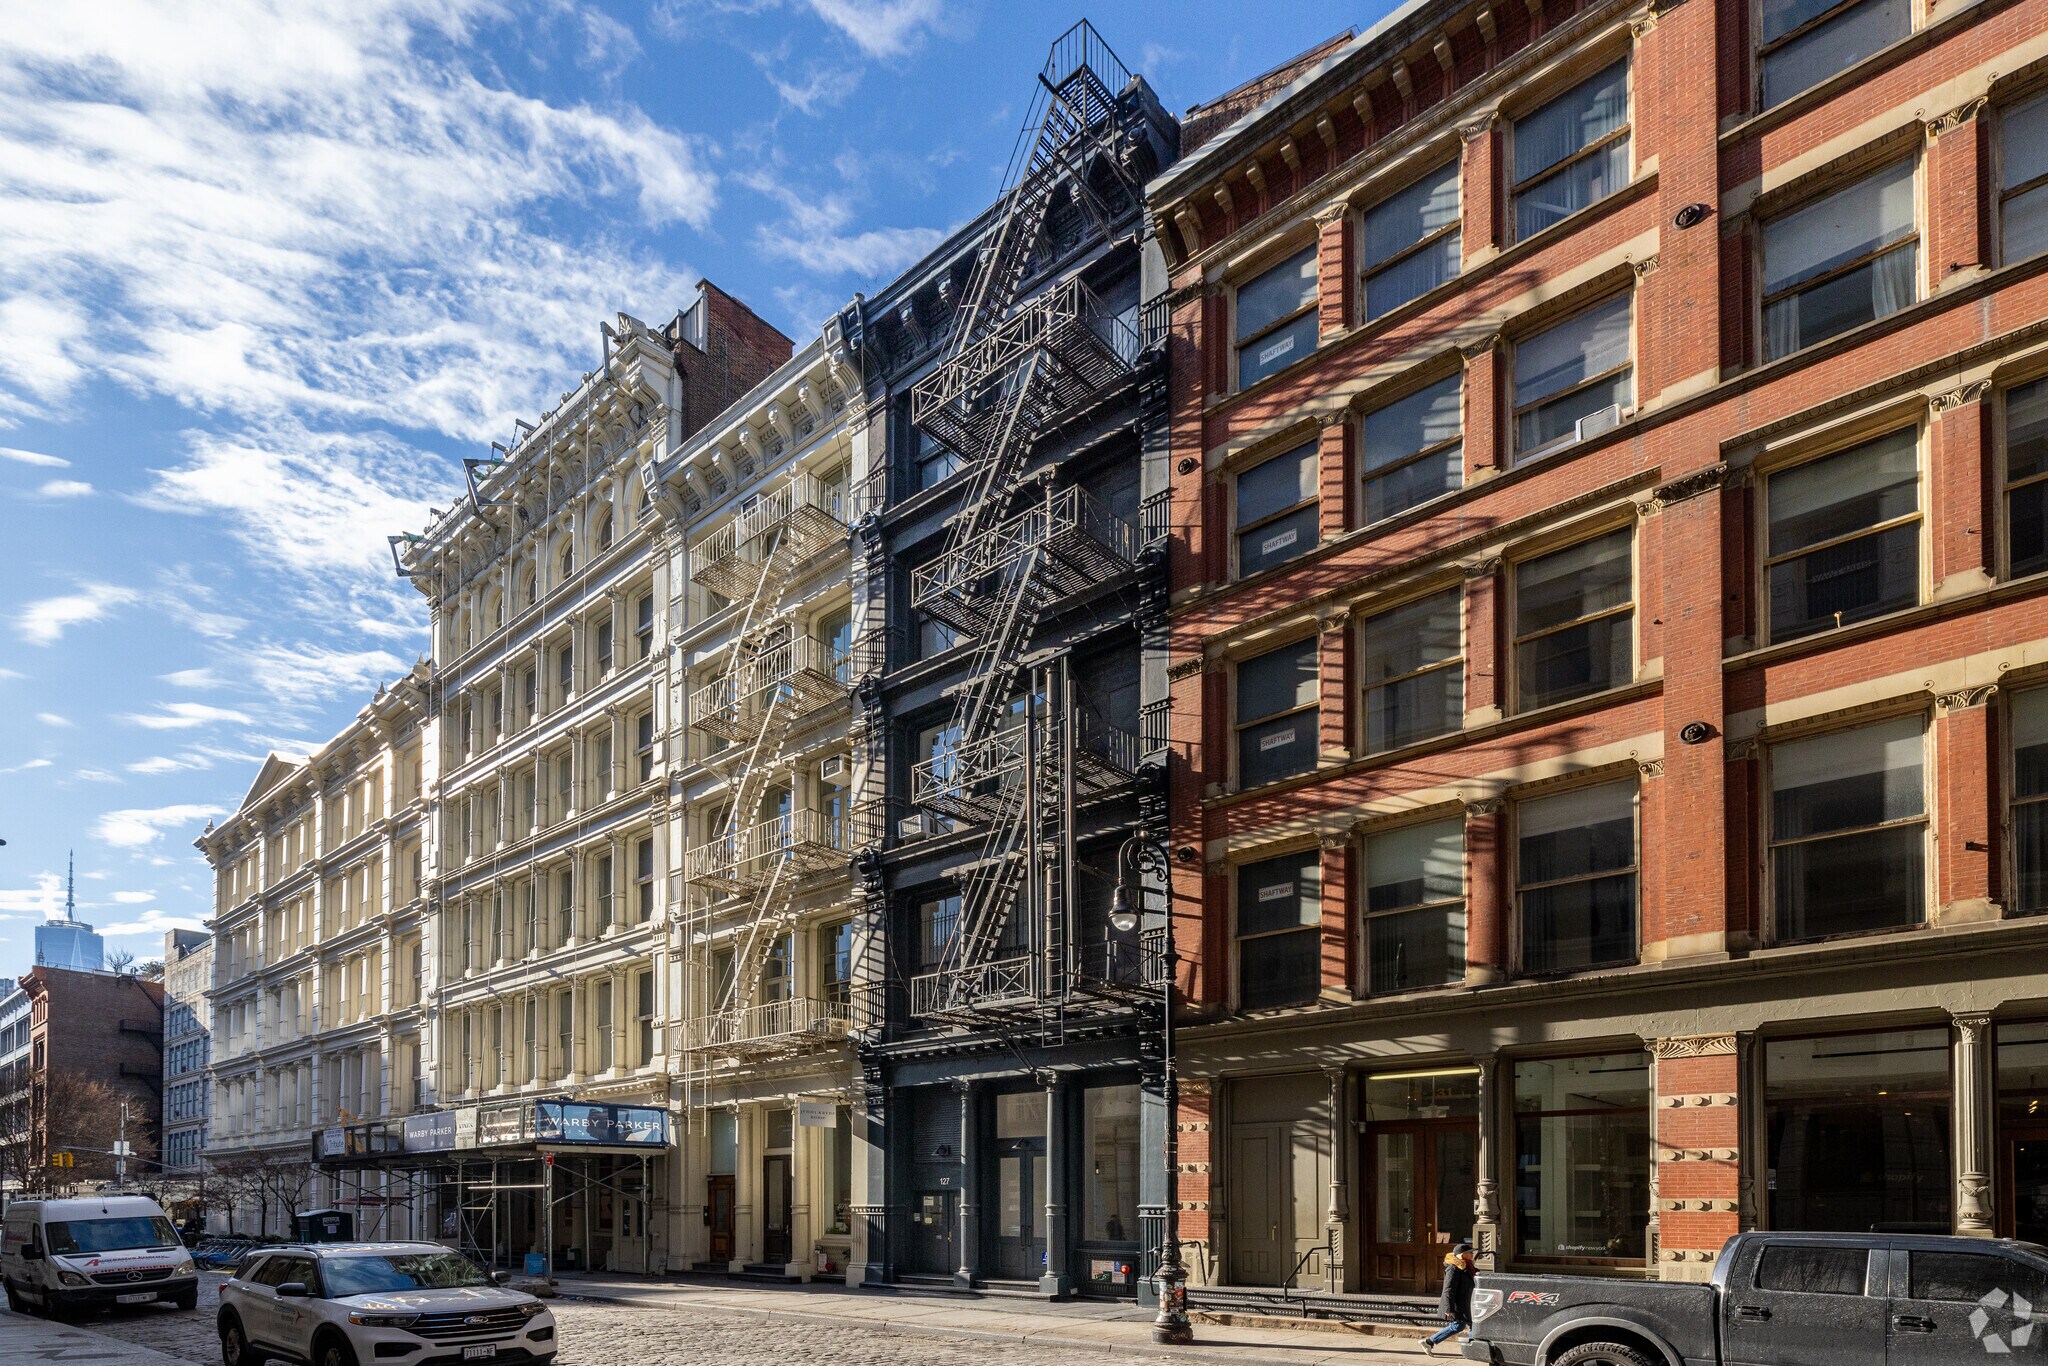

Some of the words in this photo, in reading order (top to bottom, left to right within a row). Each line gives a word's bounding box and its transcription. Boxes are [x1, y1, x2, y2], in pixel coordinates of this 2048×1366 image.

[1261, 339, 1293, 361] SHAFTWAY
[1263, 532, 1296, 551] SHAFTWAY
[1261, 732, 1294, 747] SHAFTWAY
[1260, 885, 1293, 899] SHAFTWAY
[545, 1117, 600, 1129] WARBY
[606, 1119, 660, 1130] PARKER
[409, 1130, 428, 1138] WARBY
[429, 1126, 452, 1136] PARKER
[940, 1178, 950, 1186] 127
[1507, 1291, 1560, 1304] FX4
